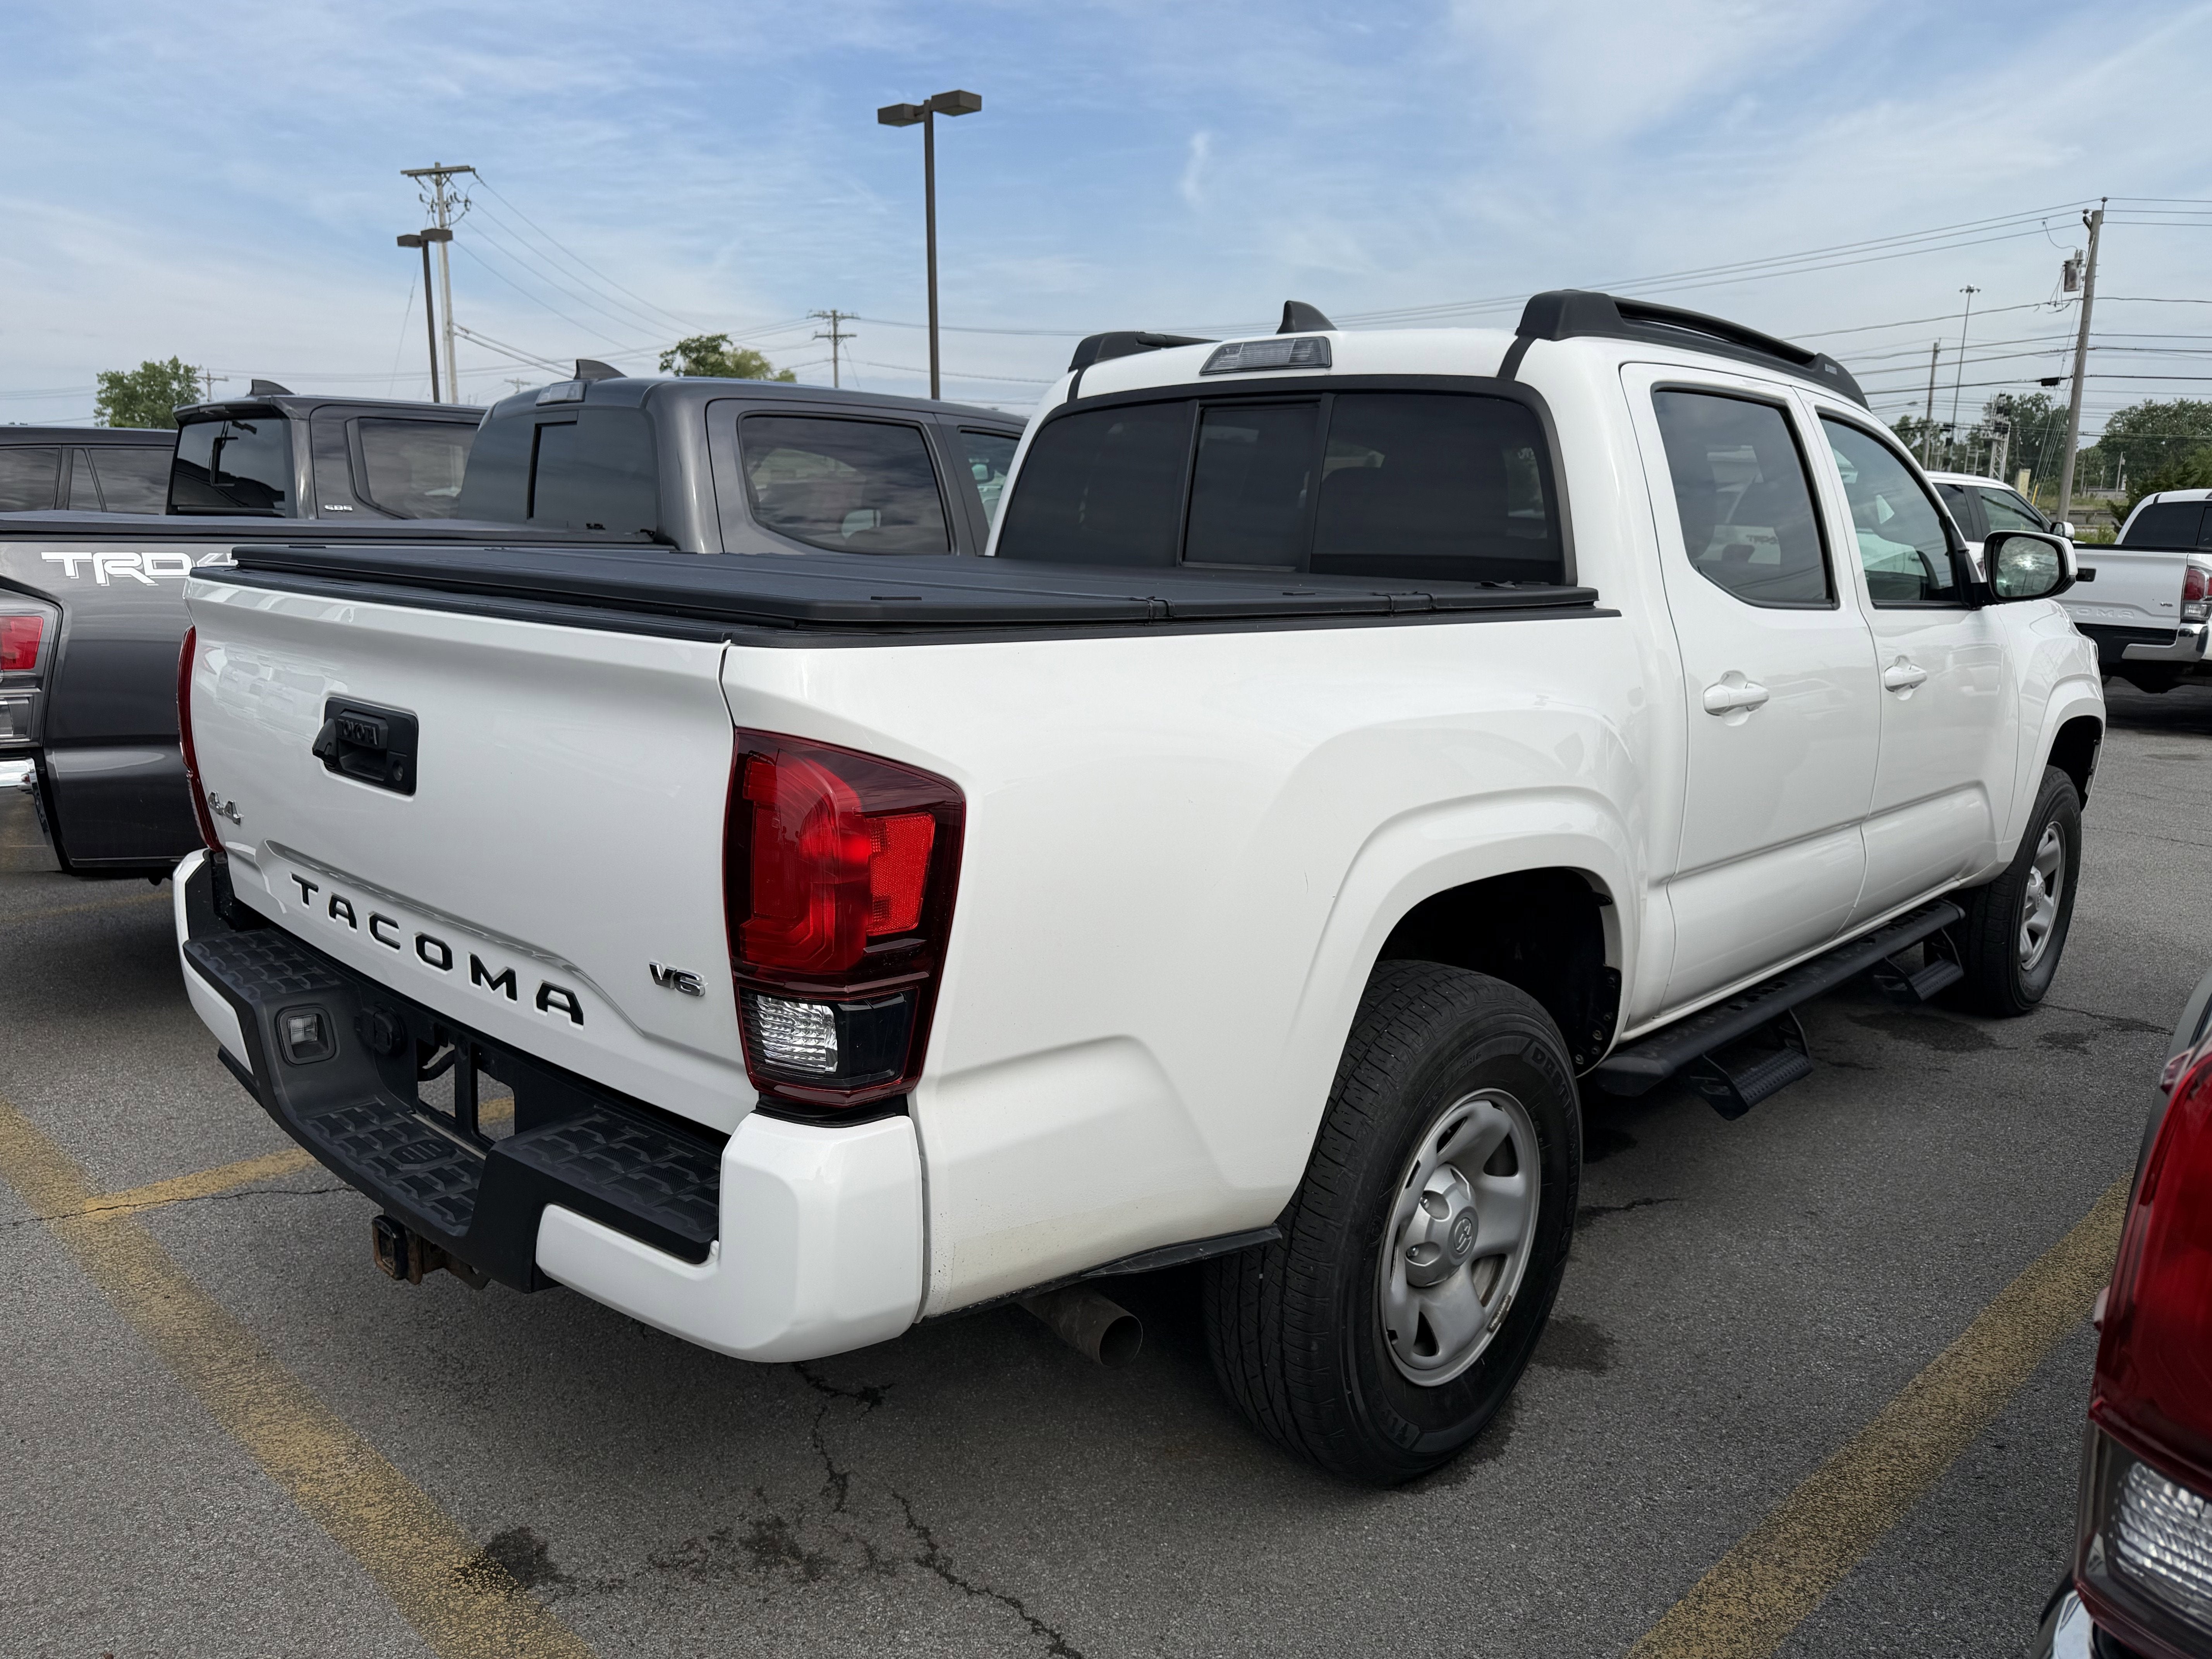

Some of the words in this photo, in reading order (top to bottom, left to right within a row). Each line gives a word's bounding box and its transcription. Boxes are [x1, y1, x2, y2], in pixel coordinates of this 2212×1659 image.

[41, 552, 193, 586] TRD
[337, 718, 378, 745] TOYOTA
[290, 872, 584, 1030] TACOMA
[649, 962, 705, 996] V6
